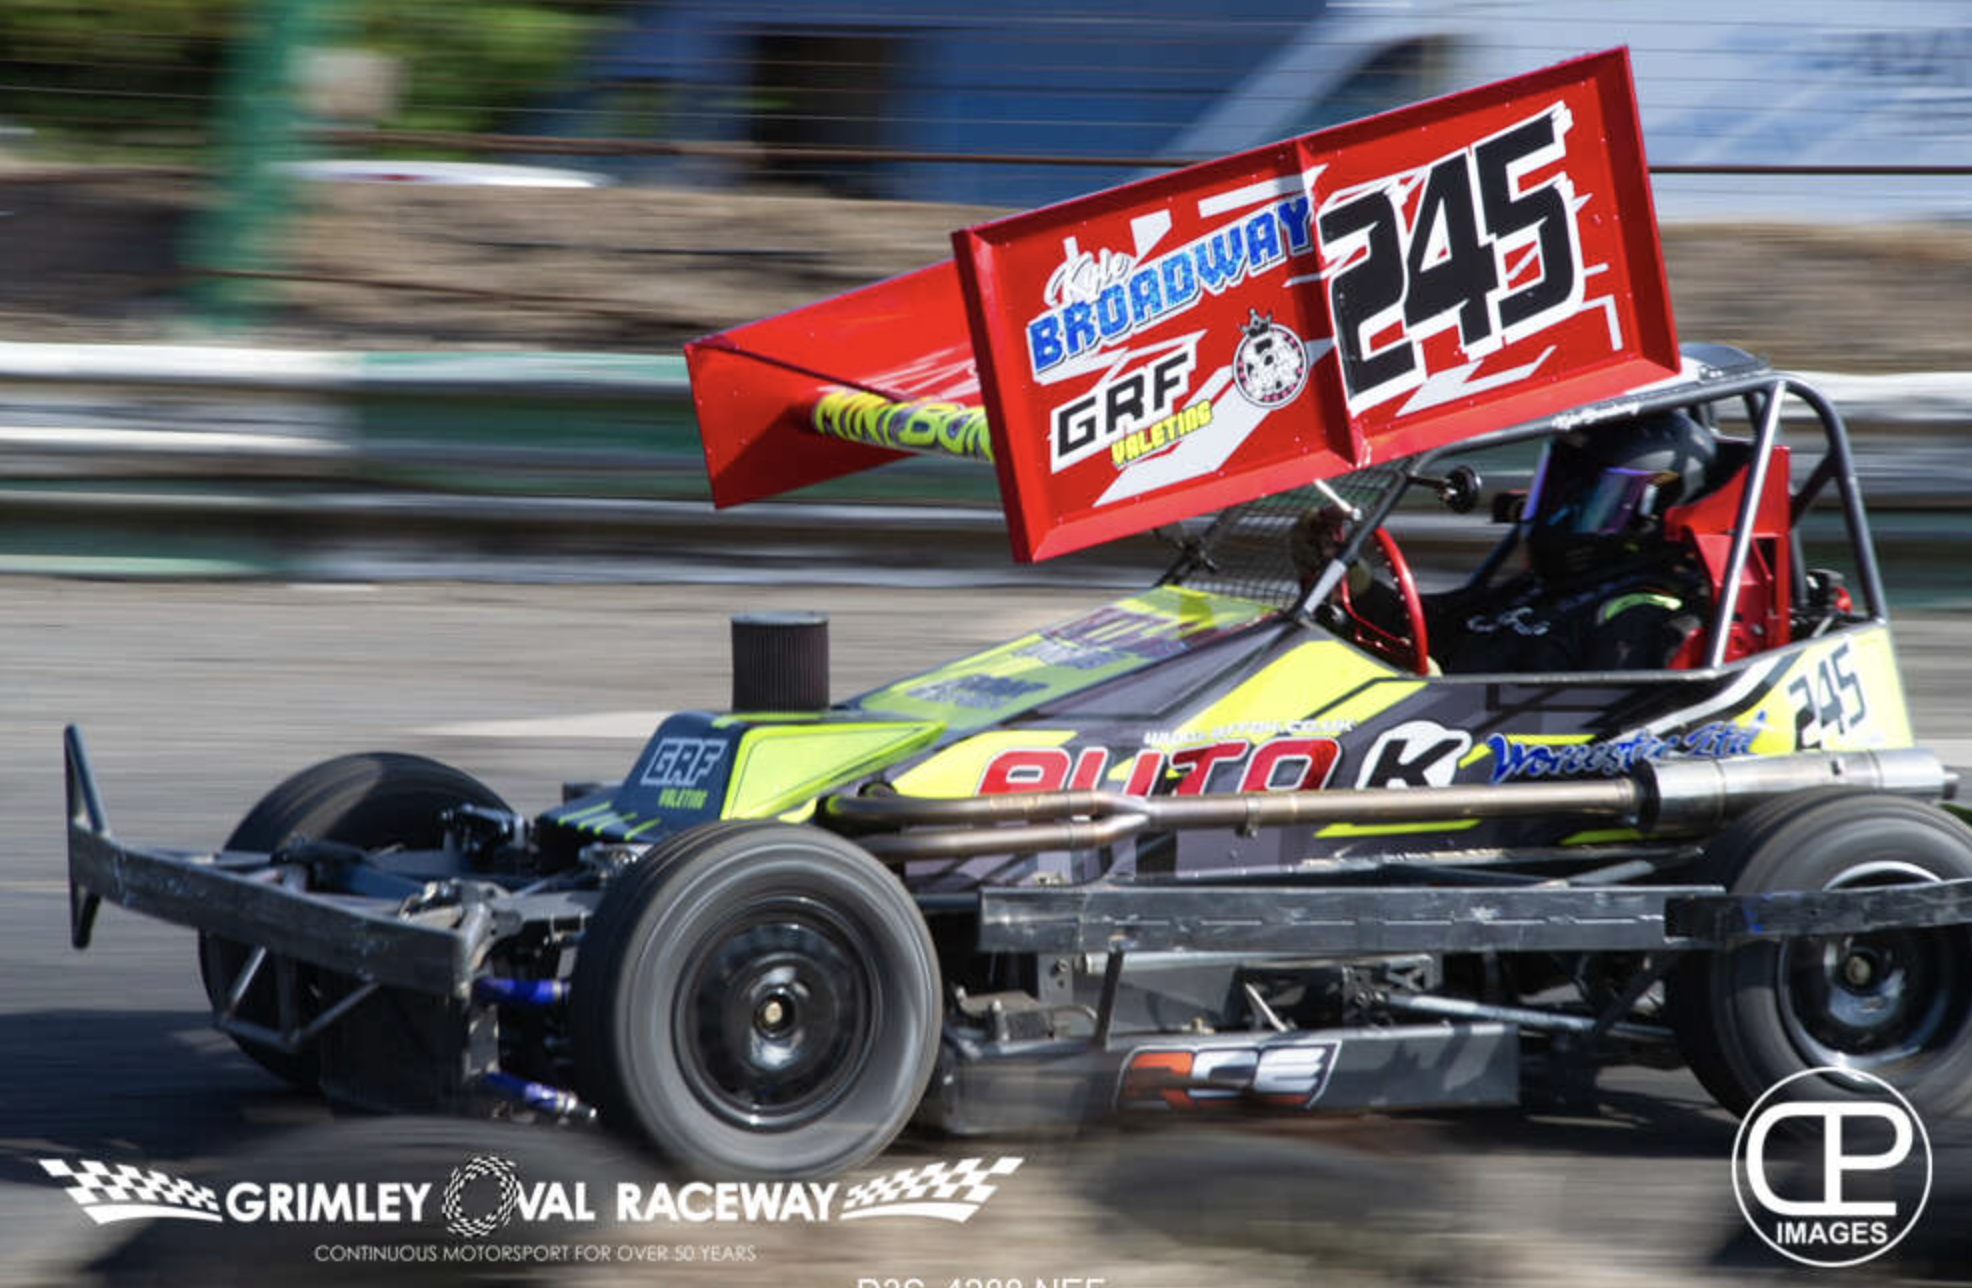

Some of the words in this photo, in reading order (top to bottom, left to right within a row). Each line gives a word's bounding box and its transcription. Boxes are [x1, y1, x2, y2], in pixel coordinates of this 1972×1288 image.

[1027, 196, 1311, 373] BROADWAY
[1044, 247, 1136, 304] Kyle
[1317, 106, 1582, 404] 245
[1055, 349, 1191, 460] GRF
[1110, 398, 1213, 468] VALETING
[1787, 641, 1866, 752] 245
[640, 738, 728, 786] GRF
[976, 737, 1341, 798] AUTO
[1361, 731, 1470, 790] K
